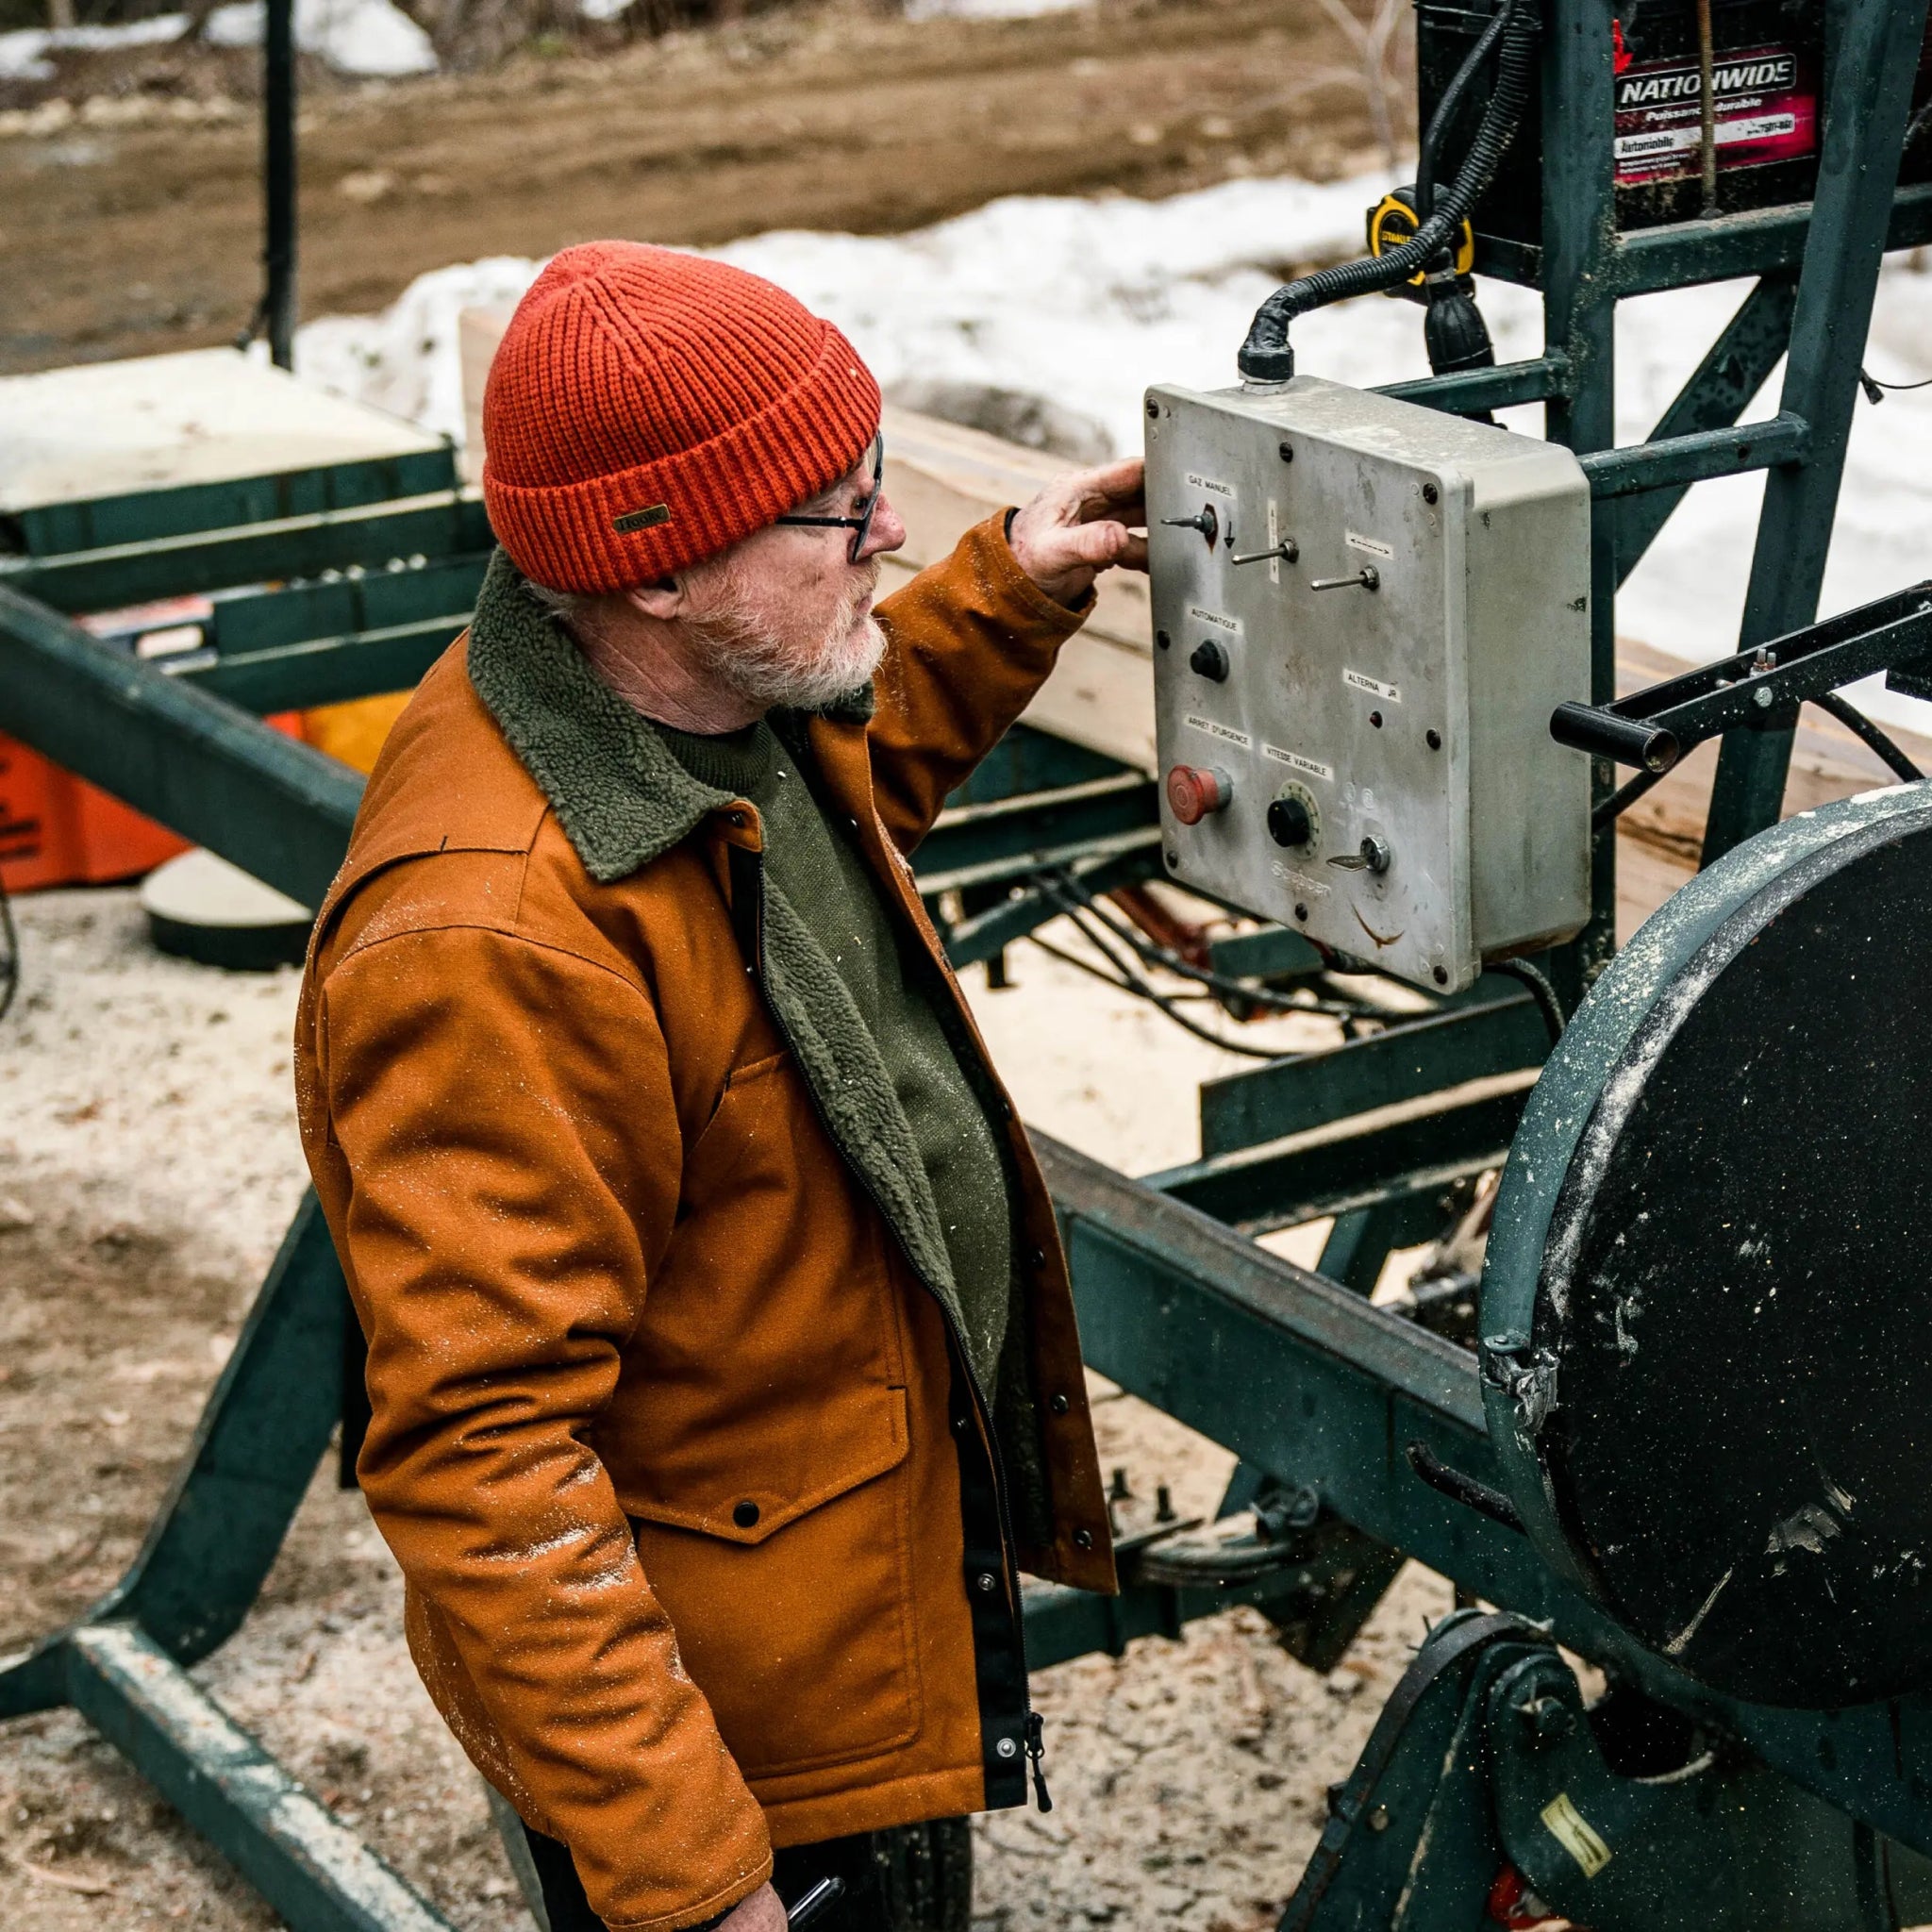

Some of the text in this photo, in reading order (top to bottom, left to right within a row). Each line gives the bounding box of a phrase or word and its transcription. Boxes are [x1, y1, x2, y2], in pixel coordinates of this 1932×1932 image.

[1645, 107, 1703, 122] Puissanc
[1621, 136, 1674, 153] Automobile
[1381, 230, 1412, 245] STANLE
[1189, 475, 1232, 496] GAZ MANUEL
[1191, 608, 1238, 631] AUTOMATIQUE
[1348, 673, 1397, 698] ALTERNA JR
[1189, 717, 1249, 745] ARRET D'URGENCE
[1266, 746, 1326, 776] VITESSE VARIABLE
